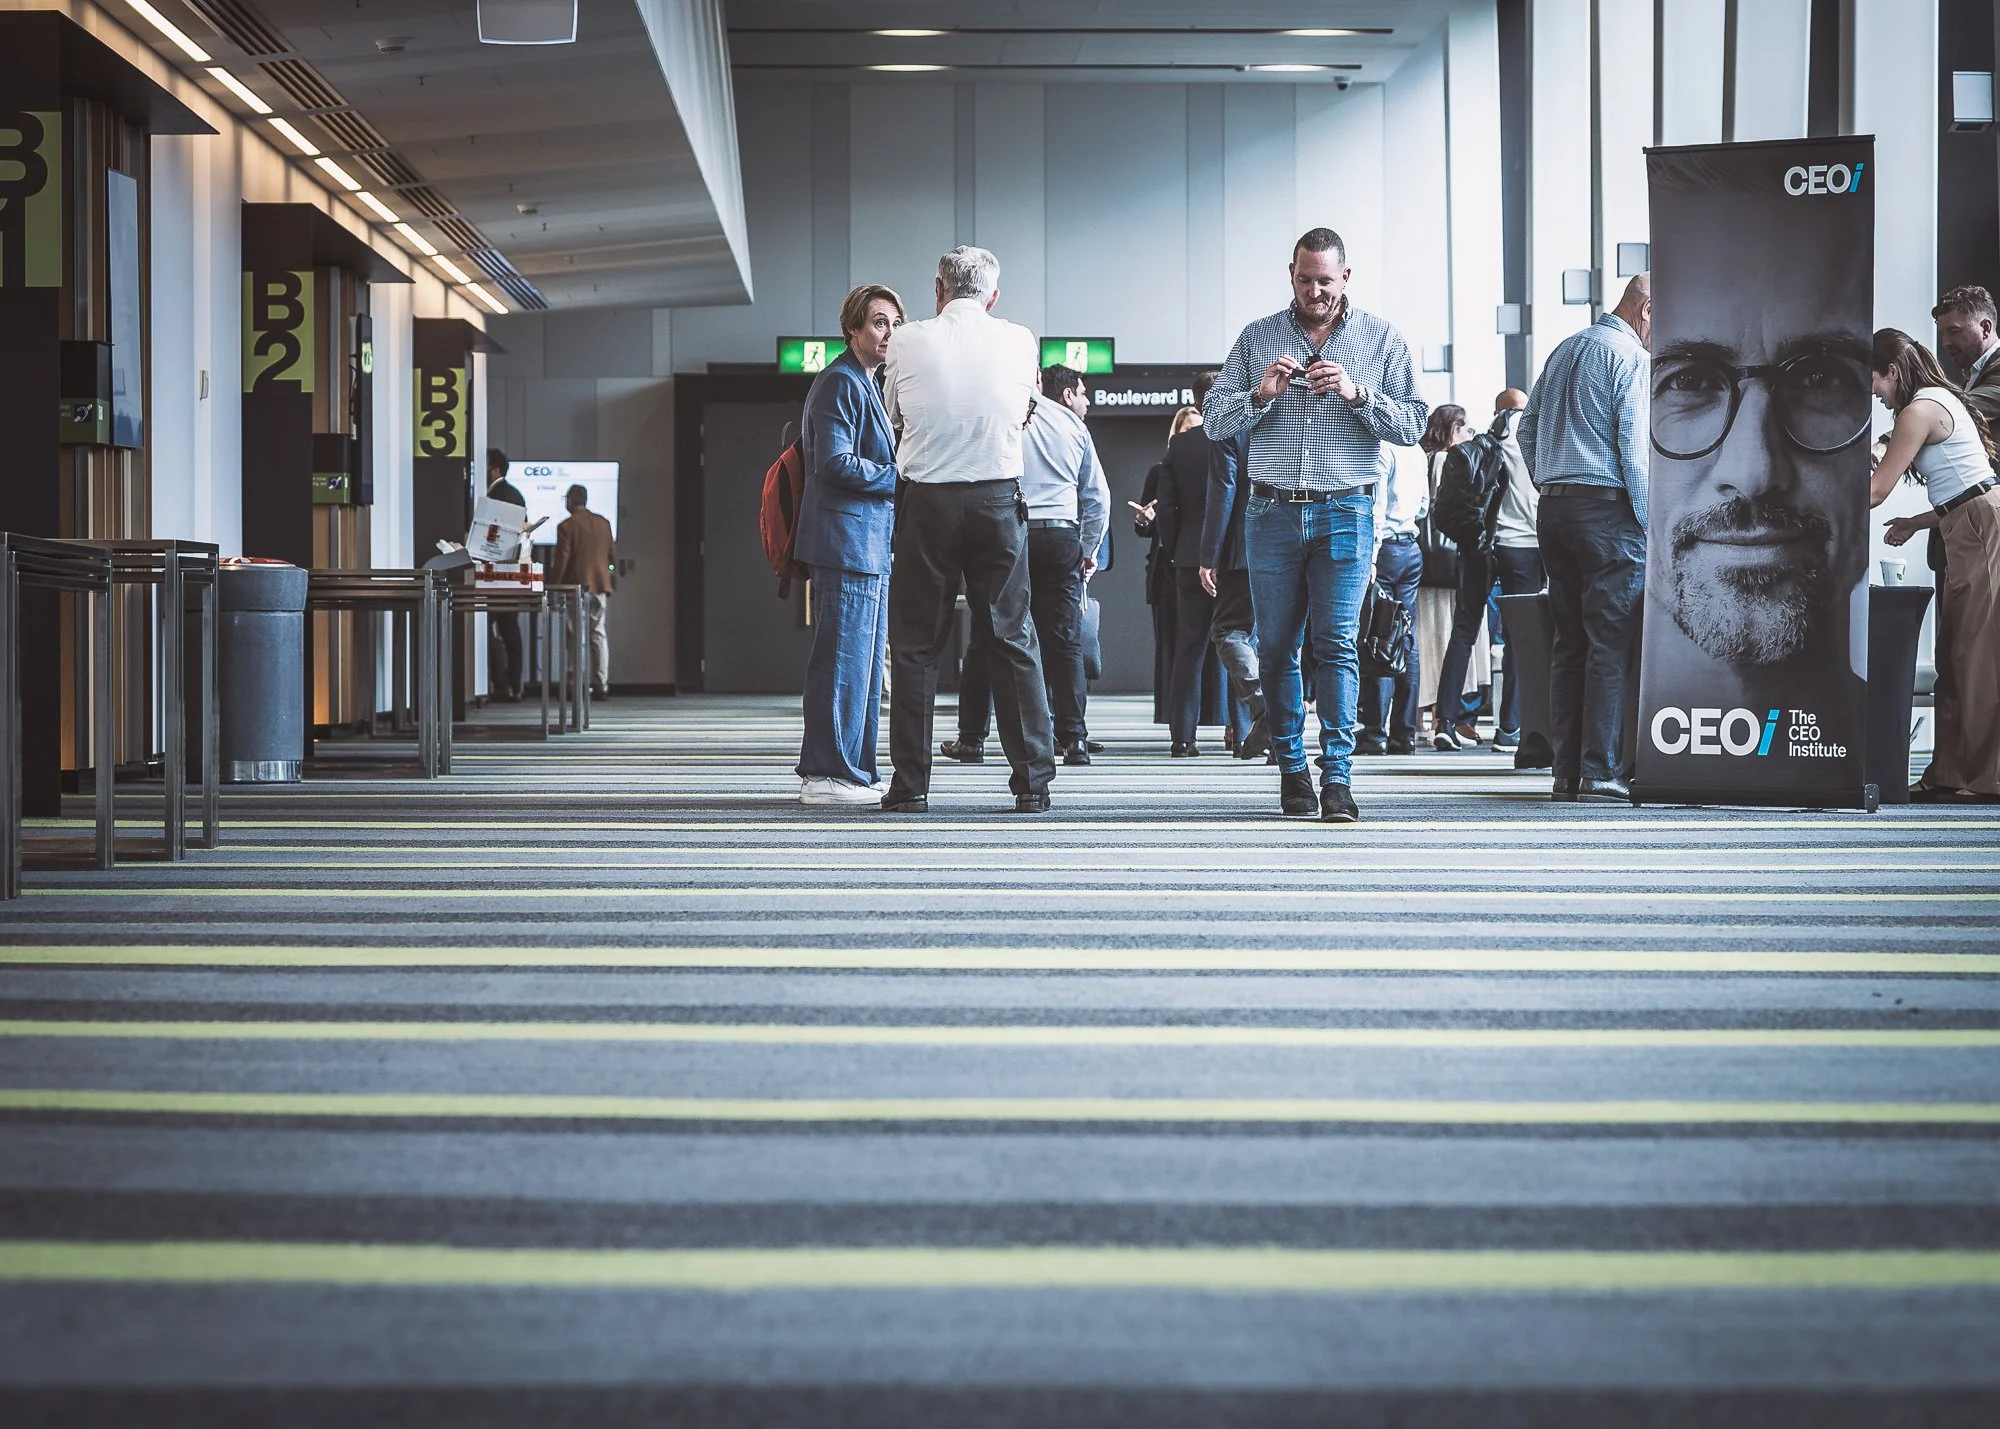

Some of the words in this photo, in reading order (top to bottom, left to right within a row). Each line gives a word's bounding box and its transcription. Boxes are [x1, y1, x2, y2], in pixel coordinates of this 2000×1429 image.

[1784, 163, 1864, 196] CEOi
[1094, 388, 1178, 405] Boulevard
[1788, 709, 1817, 725] The
[1651, 706, 1780, 757] CEOi
[1788, 726, 1821, 741] CEO
[1788, 742, 1847, 758] Institute
